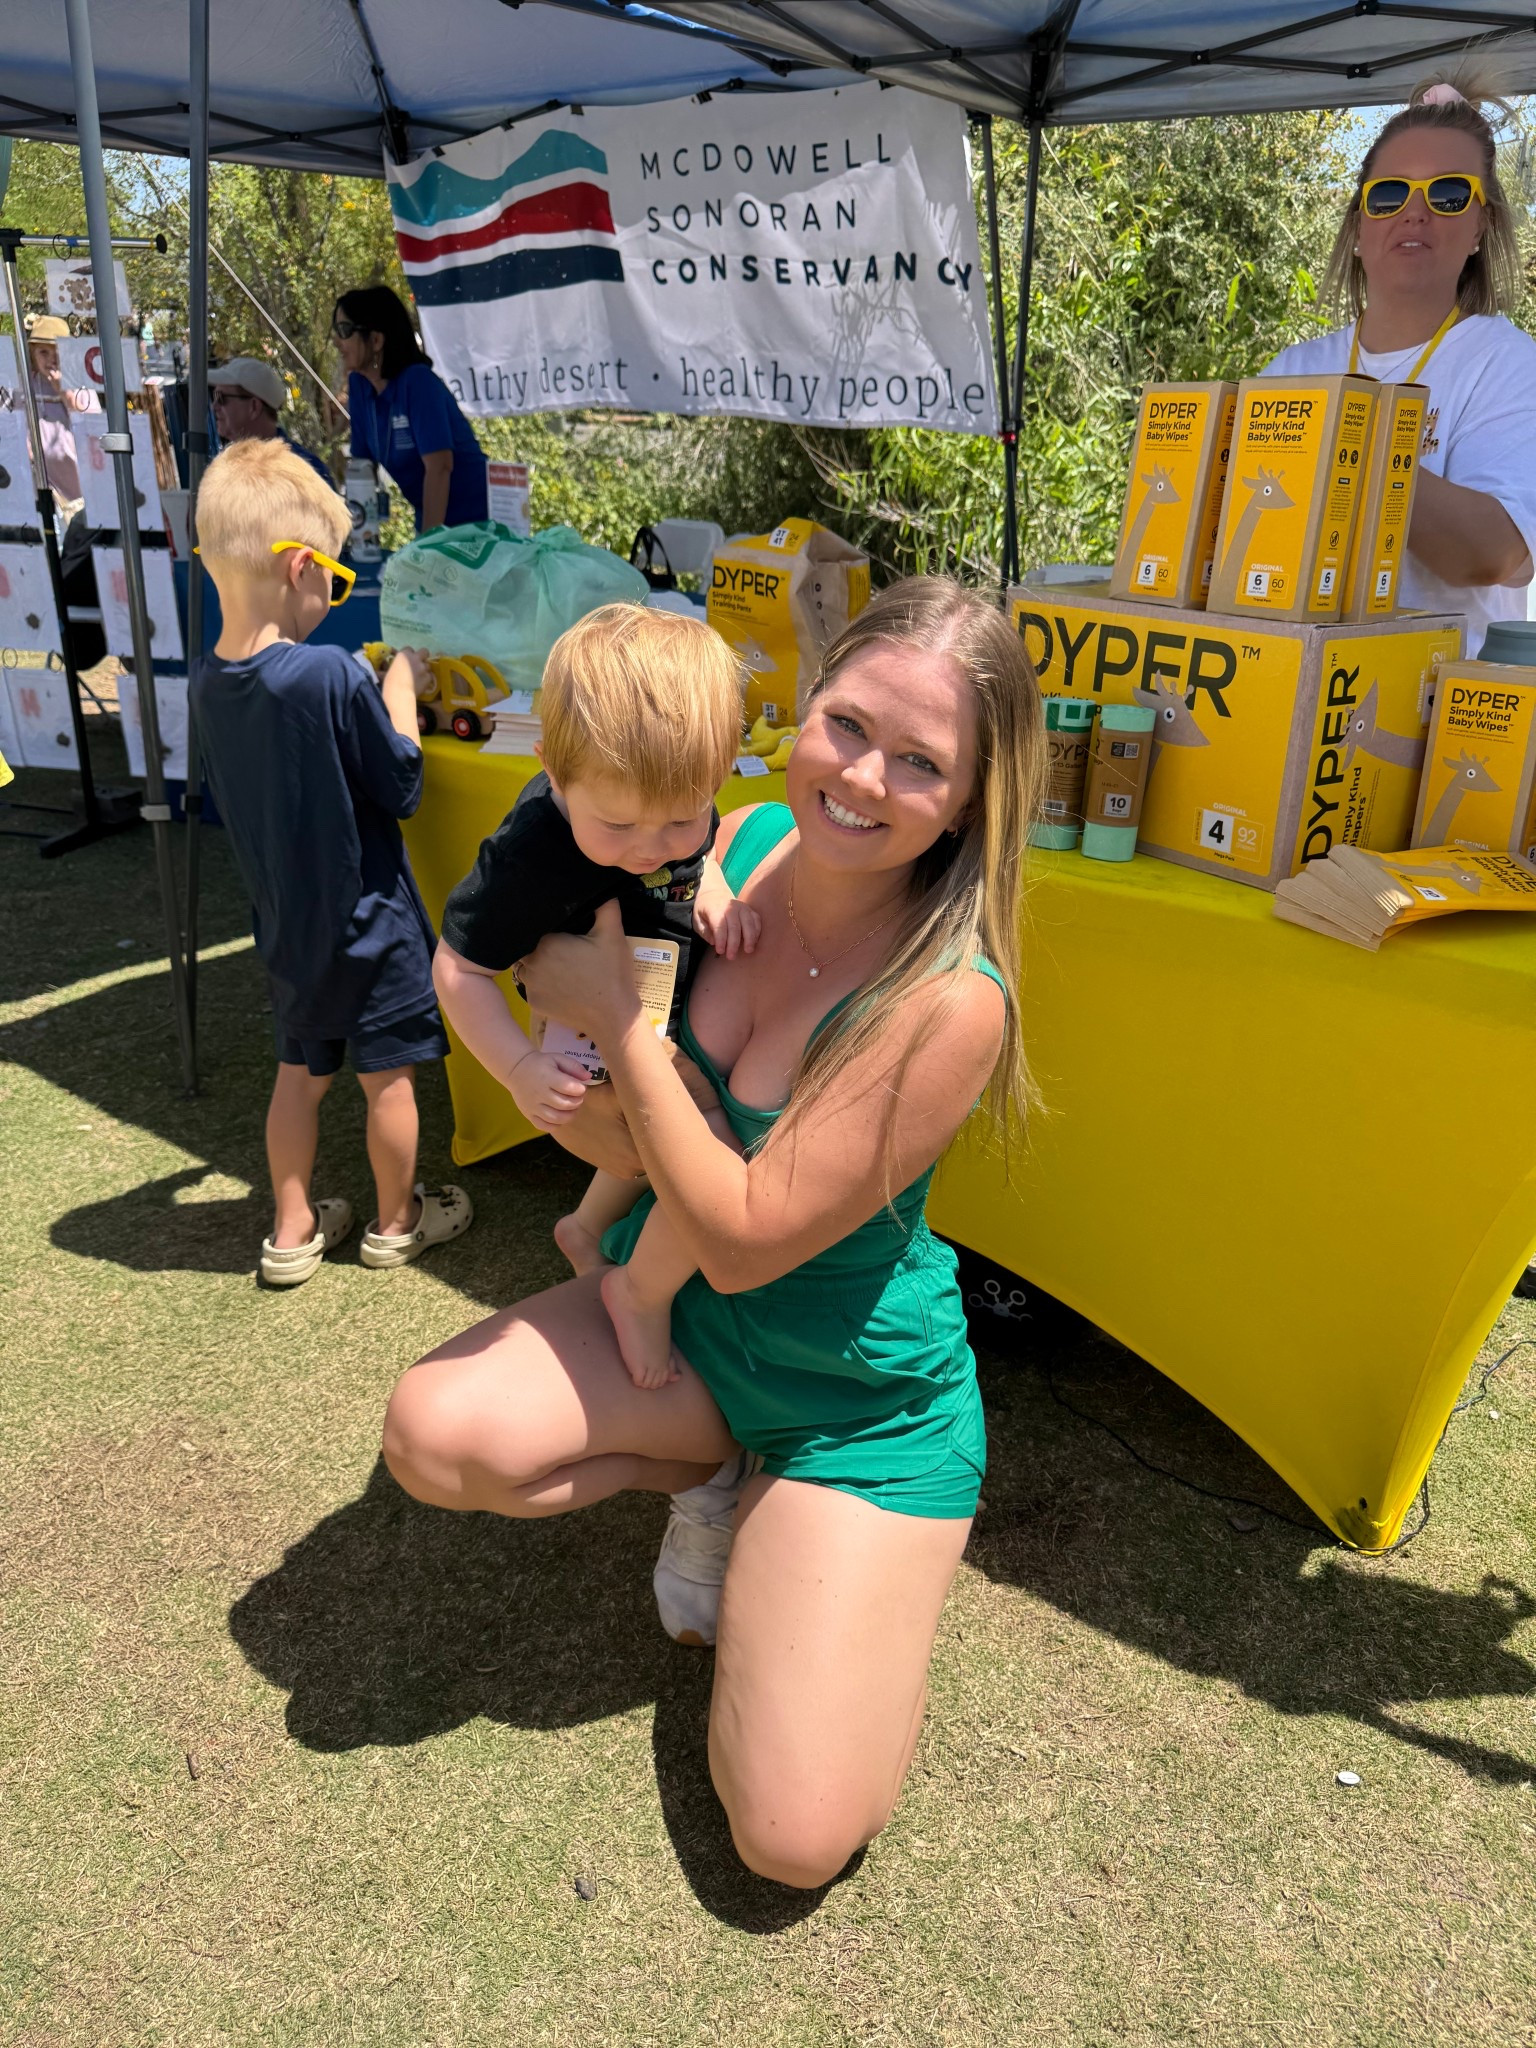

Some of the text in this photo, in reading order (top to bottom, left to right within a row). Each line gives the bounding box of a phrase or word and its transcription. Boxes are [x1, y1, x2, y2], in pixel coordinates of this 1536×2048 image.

[641, 132, 892, 180] MCDOWELL
[648, 198, 857, 234] SONORAN
[653, 251, 973, 292] CONSERVANCY
[450, 357, 986, 421] althy desert healthy people
[1148, 421, 1191, 431] Simply Kind
[1249, 421, 1305, 432] Simply Kind
[1147, 432, 1164, 442] Baby
[1248, 432, 1271, 443] Baby
[776, 529, 787, 537] 3T
[773, 537, 782, 545] 4T
[1145, 565, 1151, 575] 6
[1158, 569, 1168, 578] 60
[1251, 563, 1284, 572] ORIGINAL
[1254, 574, 1262, 586] 6
[1272, 579, 1284, 588] 60
[1324, 572, 1331, 584] 6
[1381, 574, 1387, 586] 6
[712, 591, 746, 603] Simply Kind
[713, 600, 752, 613] Training Pants
[764, 704, 774, 713] 3T
[1450, 706, 1511, 722] Simply Kind
[765, 711, 775, 720] 4T
[1448, 716, 1475, 729] Baby
[1110, 796, 1126, 809] 10
[1341, 766, 1362, 845] mply Kind
[1213, 802, 1247, 817] ORIGINAL
[1208, 820, 1225, 843] 4
[1238, 827, 1257, 846] 92
[1454, 839, 1490, 851] ORIGINAL
[582, 1053, 601, 1062] Happy
